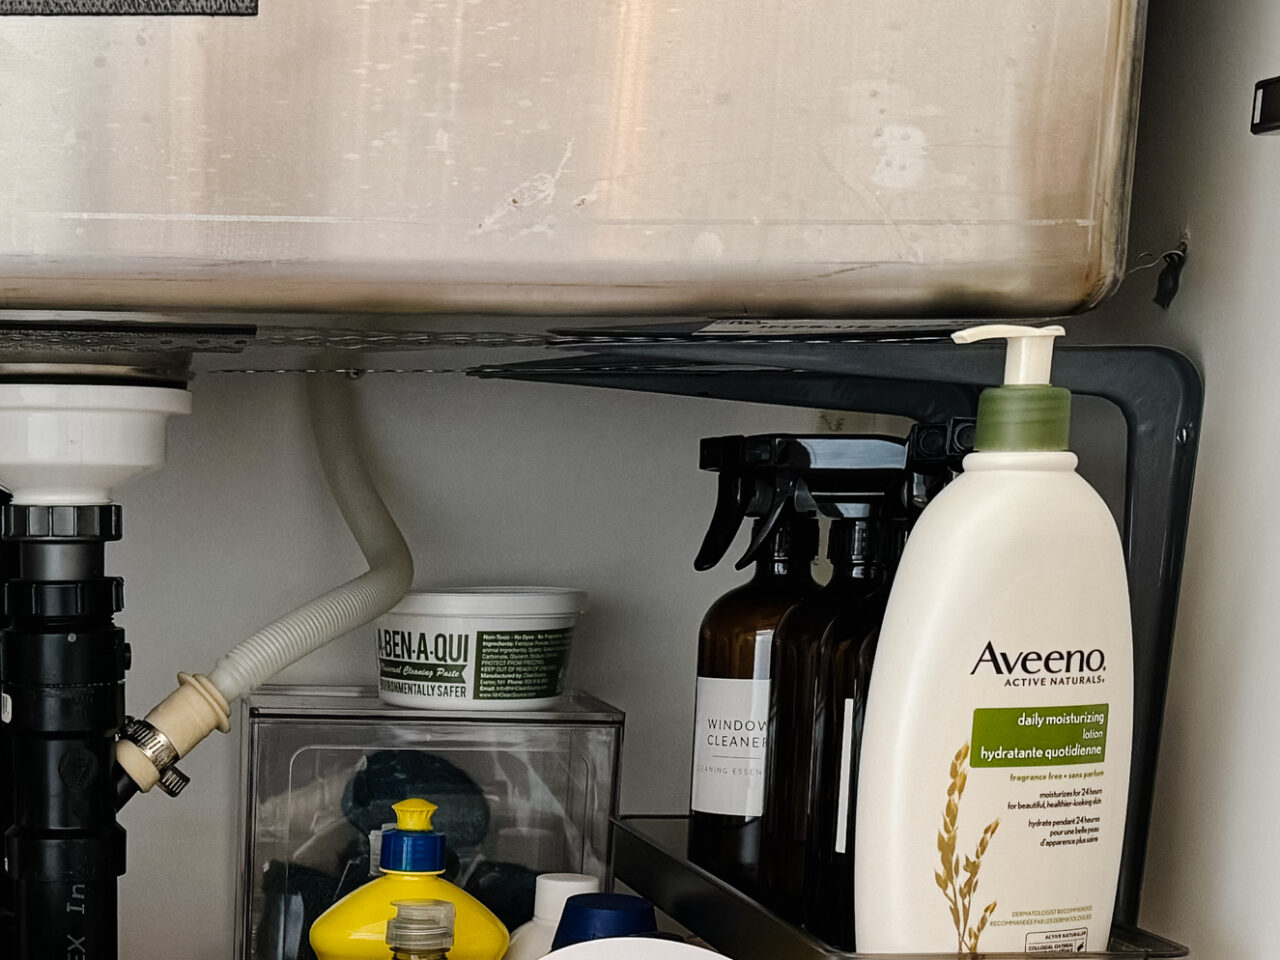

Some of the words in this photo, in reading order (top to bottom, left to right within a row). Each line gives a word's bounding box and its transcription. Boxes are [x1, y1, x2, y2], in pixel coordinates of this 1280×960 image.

[970, 640, 1105, 675] Aveeno
[403, 665, 433, 678] Cleaning
[437, 667, 459, 678] Paste
[1004, 677, 1046, 687] ACTIVE
[1050, 675, 1101, 686] NATURALS
[437, 685, 466, 698] SAFER
[1017, 712, 1044, 727] daily
[1046, 711, 1104, 725] moisturizing
[1083, 728, 1103, 740] lotion
[980, 746, 1043, 761] hydratante
[1045, 743, 1101, 759] quotidienne
[1008, 802, 1016, 810] for
[1076, 816, 1083, 825] 24
